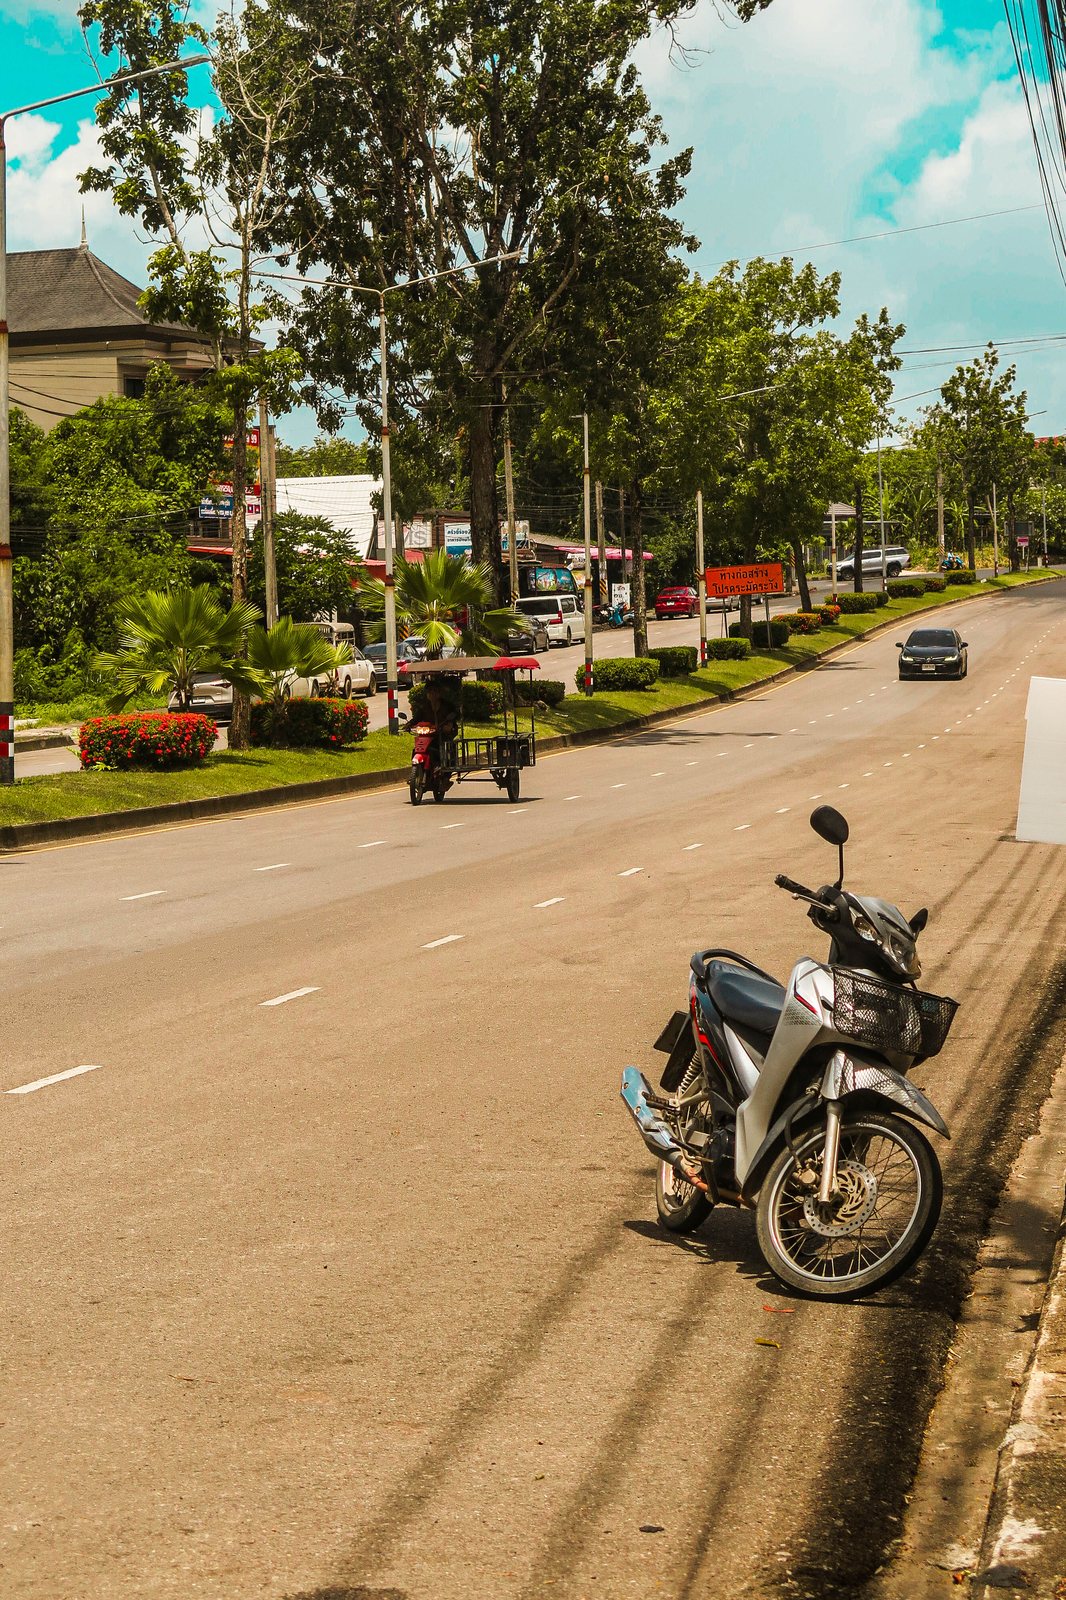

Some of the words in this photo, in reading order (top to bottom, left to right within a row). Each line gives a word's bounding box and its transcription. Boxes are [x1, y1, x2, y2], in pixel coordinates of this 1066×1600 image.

[719, 567, 769, 580] ทางก่อสร้าง
[711, 579, 779, 594] โปรดระมัดระวัง
